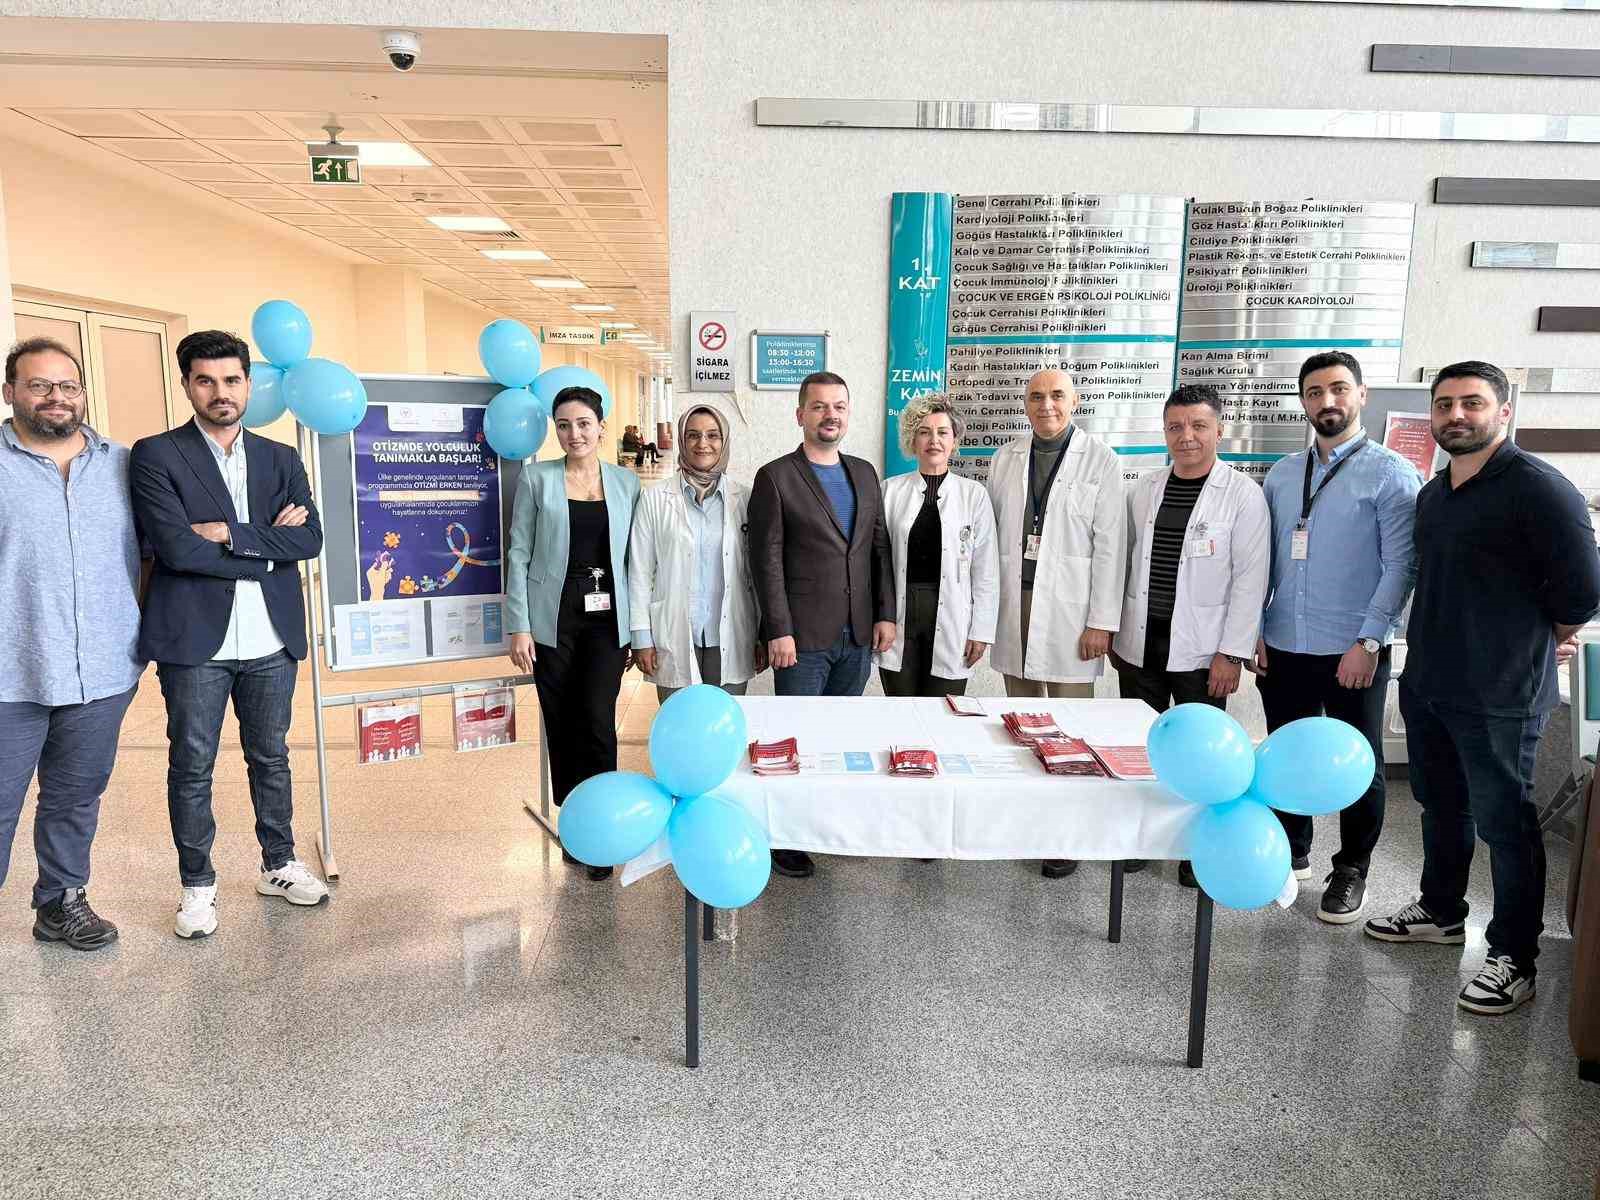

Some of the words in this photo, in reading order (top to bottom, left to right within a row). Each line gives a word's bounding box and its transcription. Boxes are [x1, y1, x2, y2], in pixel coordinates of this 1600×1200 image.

[957, 199, 987, 209] Genel
[991, 198, 1031, 207] Cerrahi
[1034, 197, 1100, 207] Polilinikleri
[1192, 205, 1224, 215] Kulak
[1227, 205, 1261, 213] Burun
[1264, 204, 1298, 214] Boğaz
[1301, 204, 1363, 213] Poliklinikleri
[956, 214, 1015, 225] Kardiyoloji
[1281, 219, 1344, 228] Poliklinikleri
[956, 230, 992, 241] Göğüs
[1058, 229, 1123, 238] Poliklinikleri
[1190, 236, 1228, 247] Cildiye
[954, 247, 979, 257] Kalp
[998, 246, 1034, 255] Damar
[1037, 245, 1085, 254] Cerrahisi
[1088, 245, 1150, 254] Poliklinikleri
[1188, 251, 1224, 261] Plastik
[1284, 250, 1317, 259] Estetik
[1319, 250, 1352, 259] Cerrahi
[1354, 251, 1406, 261] Poliklinikleri
[954, 262, 989, 272] Çocuk
[991, 260, 1029, 272] Sağlığı
[1032, 262, 1044, 270] ve
[1109, 261, 1169, 271] Poliklinikleri
[1187, 266, 1240, 277] Psikiyatri
[1242, 266, 1308, 275] Poliklinikleri
[898, 276, 942, 290] KAT
[953, 277, 988, 288] Çocuk
[1186, 282, 1223, 292] Üroloji
[1226, 281, 1293, 291] Poliklinikleri
[958, 292, 997, 303] ÇOCUK
[999, 292, 1014, 301] VE
[1016, 292, 1054, 301] ERGEN
[1057, 291, 1112, 301] PSİKOLOJİ
[1246, 296, 1285, 306] ÇOCUK
[1287, 294, 1354, 305] KARDİYOLOJİ
[952, 308, 986, 319] Çocuk
[988, 308, 1038, 318] Cerrahisi
[1040, 308, 1106, 317] Poliklinikleri
[952, 322, 987, 334] Göğüs
[990, 322, 1039, 332] Cerrahisi
[1041, 322, 1107, 332] Poliklinikleri
[950, 347, 992, 357] Dahiliye
[995, 347, 1061, 356] Poliklinikleri
[1181, 352, 1203, 361] Kan
[1205, 351, 1234, 360] Alma
[1236, 351, 1269, 360] Birimi
[696, 356, 729, 367] SİGARA
[950, 362, 980, 372] Kadın
[983, 361, 1041, 371] Hastalıkları
[1060, 361, 1098, 371] Doğum
[1100, 361, 1160, 370] Poliklinikleri
[695, 371, 730, 382] İÇİLMEZ
[891, 366, 941, 383] ZEMİN
[1180, 366, 1216, 377] Sağlık
[1217, 366, 1254, 375] Kurulu
[949, 377, 995, 388] Ortopedi
[1080, 376, 1142, 385] Poliklinikleri
[1229, 380, 1296, 390] Yönlendirme
[976, 392, 1011, 401] Tedavi
[1108, 391, 1166, 400] Poliklinikleri
[1221, 398, 1249, 407] Hasta
[1252, 398, 1280, 408] Kayıt
[980, 407, 1025, 416] Cerrahis
[1238, 412, 1268, 421] Hasta
[966, 422, 989, 432] oloji
[991, 421, 1032, 431] Poliklin
[372, 440, 424, 452] OTİZMDE
[425, 441, 481, 452] YOLCULUK
[960, 435, 979, 446] ebe
[982, 435, 1015, 446] Okul
[373, 453, 437, 463] TANIMAKLA
[438, 454, 482, 465] BAŞLAR!
[413, 480, 438, 489] OTİZMİ
[439, 481, 463, 489] ERKEN
